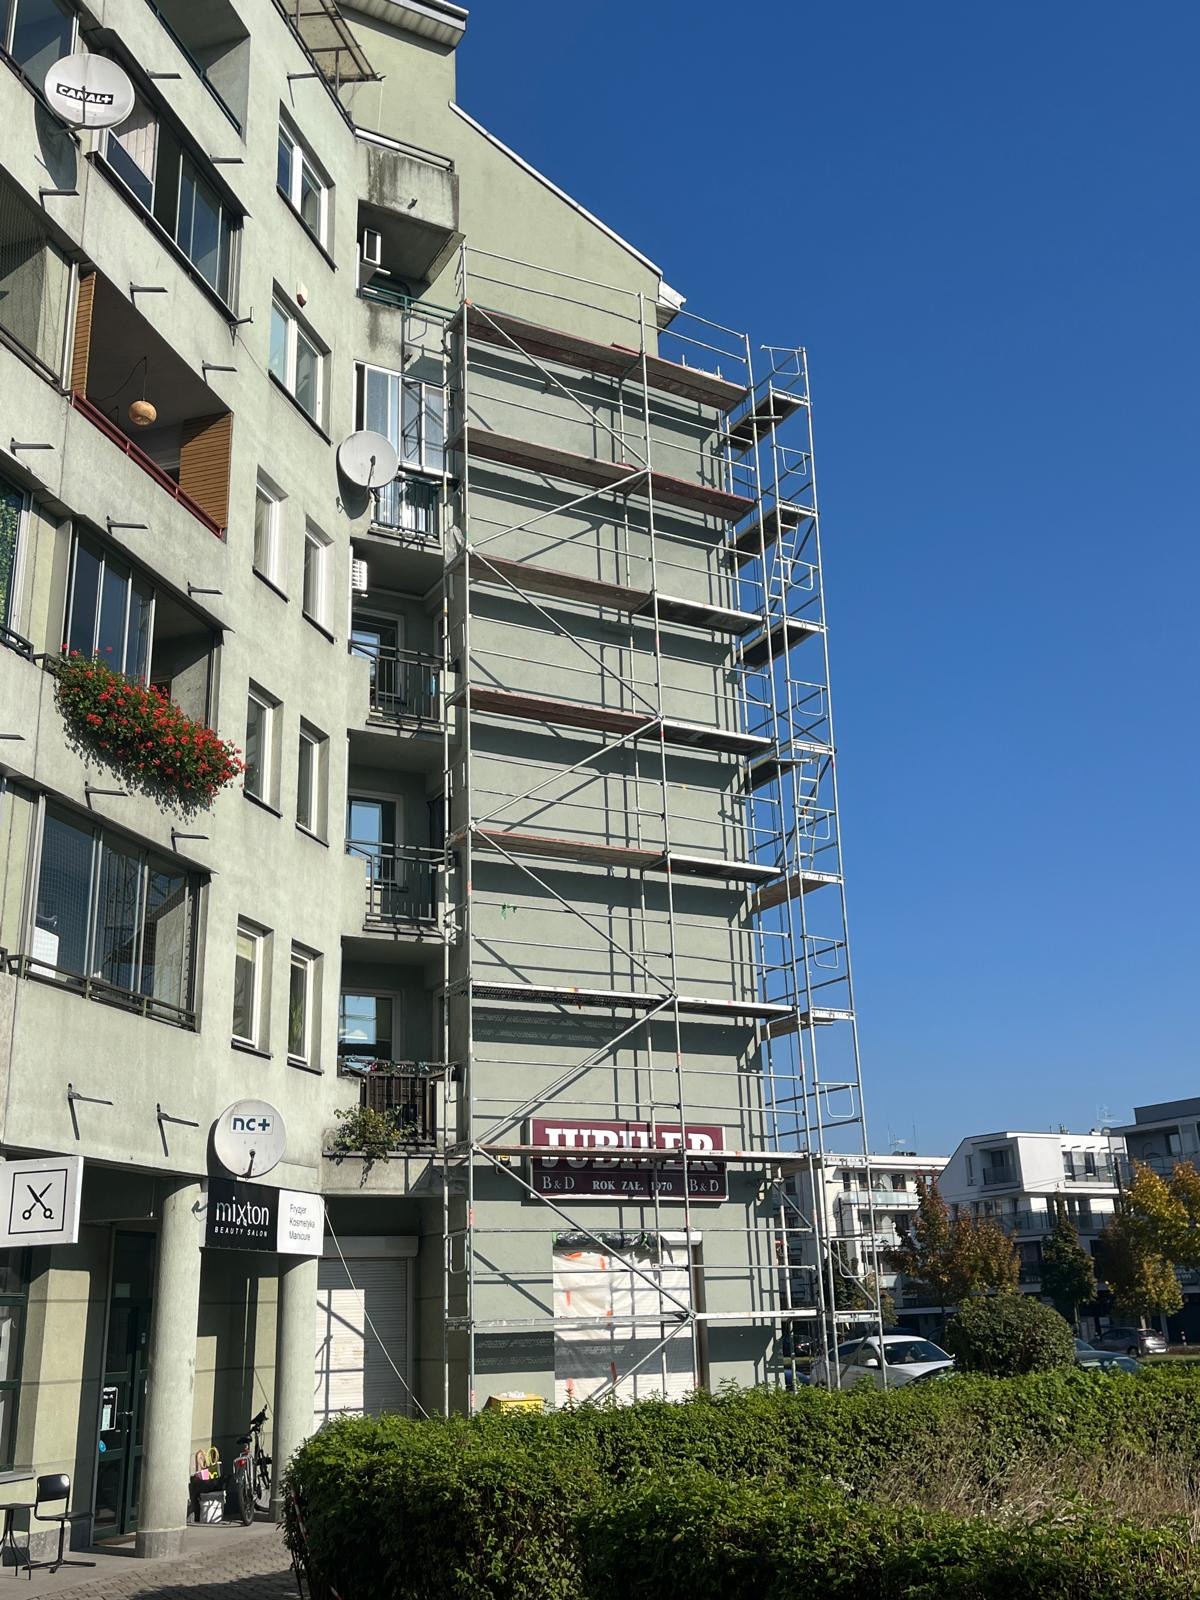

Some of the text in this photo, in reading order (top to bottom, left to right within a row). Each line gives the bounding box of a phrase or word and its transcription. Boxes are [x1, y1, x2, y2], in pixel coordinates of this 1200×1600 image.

[58, 86, 112, 103] CANAL+
[233, 1118, 270, 1131] nc+
[542, 1128, 718, 1171] JUBILER
[592, 1180, 616, 1190] ROK
[621, 1181, 644, 1191] ZAŁ.
[651, 1182, 673, 1191] 1970
[216, 1196, 269, 1227] mixton
[214, 1226, 268, 1237] BEAUTY SALON
[289, 1230, 311, 1241] Manicure
